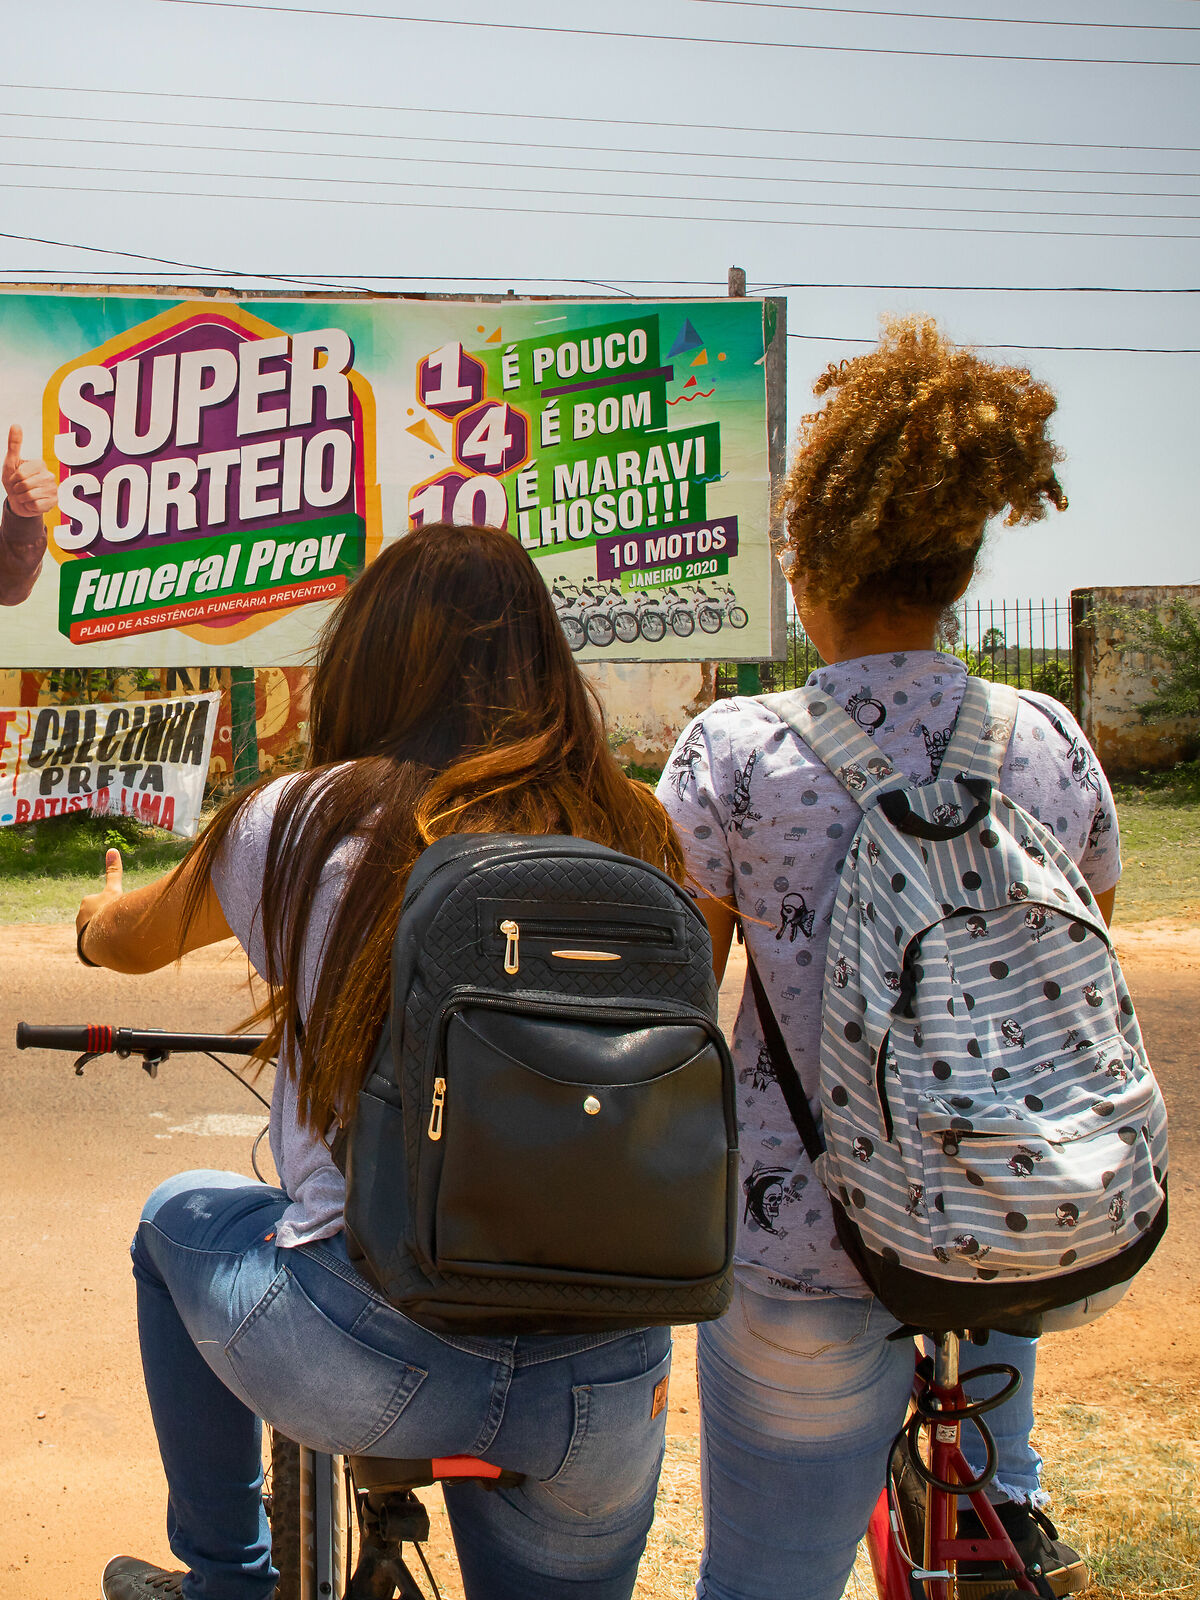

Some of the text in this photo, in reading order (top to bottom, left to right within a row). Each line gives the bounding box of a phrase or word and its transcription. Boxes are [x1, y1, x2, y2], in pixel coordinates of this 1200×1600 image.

[425, 342, 473, 406] 1
[502, 329, 648, 391] É POUCO
[54, 328, 351, 466] SUPER
[541, 391, 651, 447] É BOM
[462, 402, 512, 467] 4
[53, 429, 352, 549] SORTEIO
[409, 474, 508, 529] 10
[517, 436, 705, 509] É MARAVI
[518, 481, 690, 549] LHOSO!!!
[71, 534, 346, 614] Funeral Prev
[610, 526, 726, 568] 10 MOTOS
[629, 559, 718, 589] JANEIRO 2020
[118, 619, 133, 630] DE
[134, 607, 205, 629] ASSISTÊNCIA
[207, 597, 268, 613] FUNERÁRIA
[269, 583, 337, 604] PREVENTIVO
[28, 700, 211, 769] CALCINHA
[15, 787, 175, 832] BATISTA LIMA
[39, 764, 164, 796] PRETA
